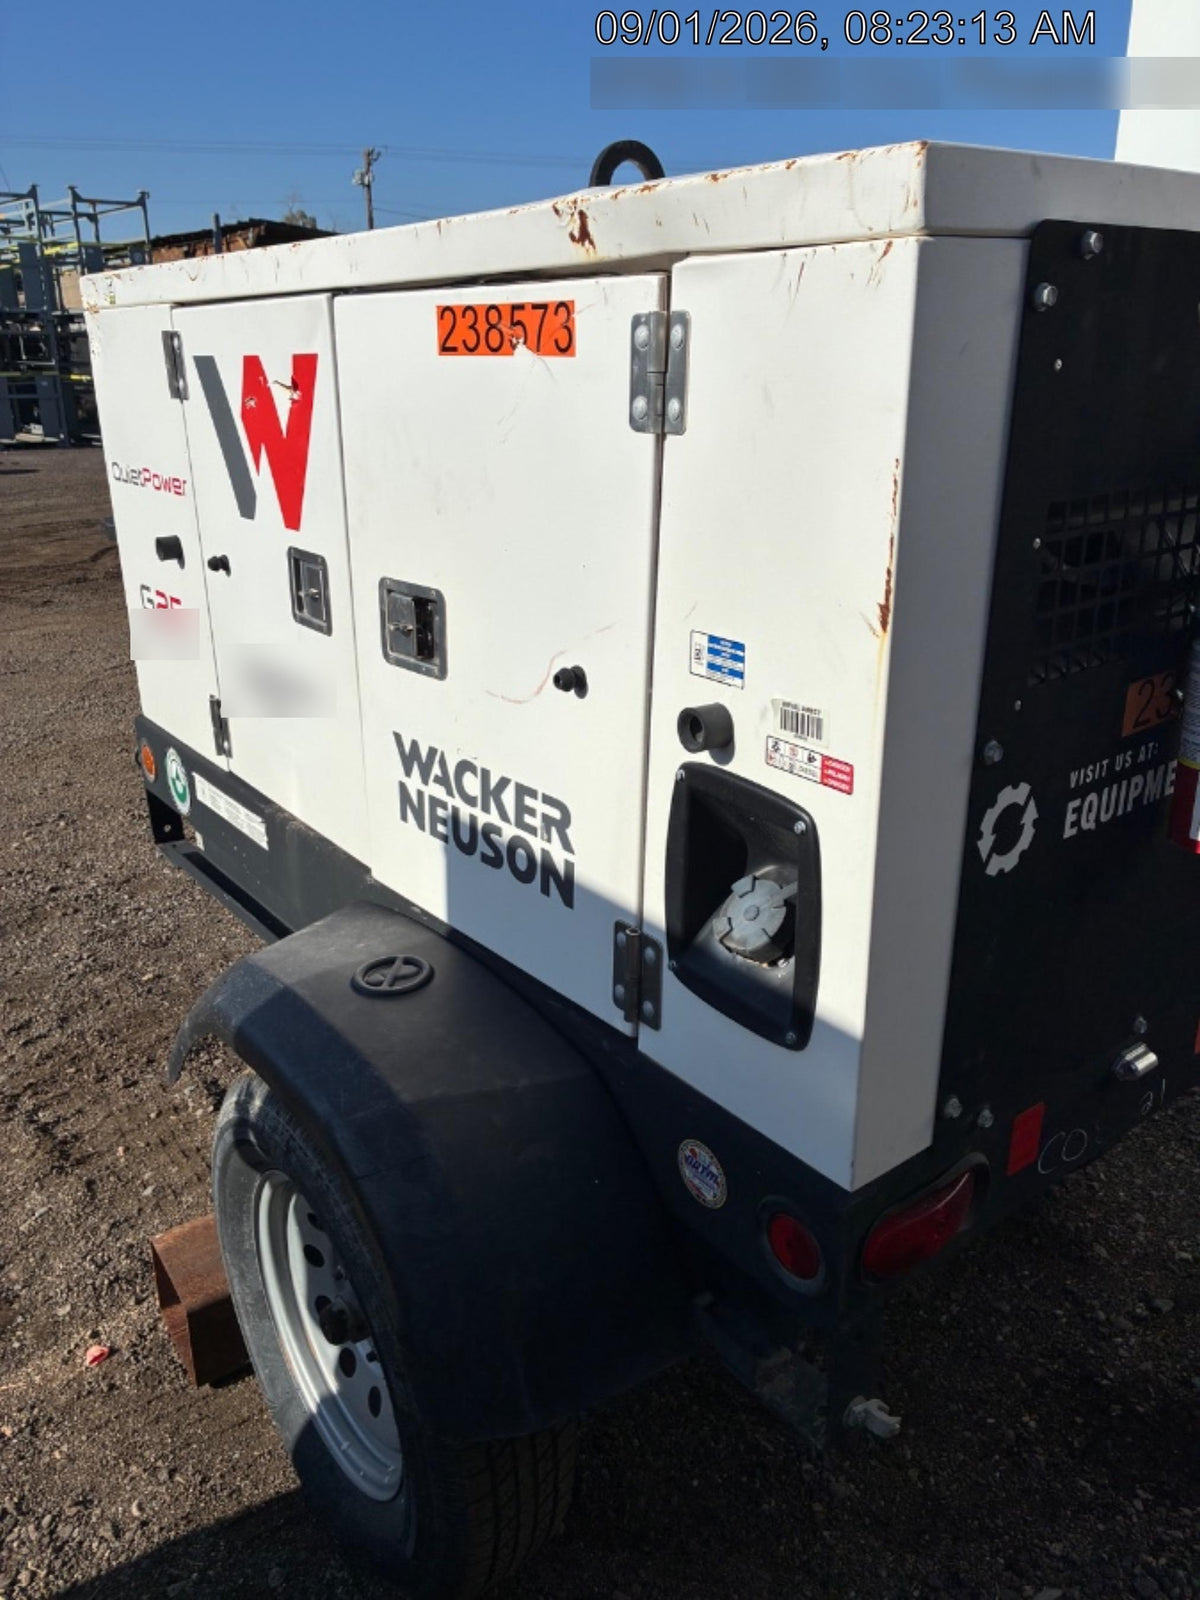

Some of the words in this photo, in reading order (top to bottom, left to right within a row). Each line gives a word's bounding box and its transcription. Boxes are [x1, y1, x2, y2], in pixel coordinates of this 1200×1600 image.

[440, 301, 574, 353] 238573
[111, 461, 187, 497] QuietPower
[1069, 758, 1109, 789] VISIT
[1115, 750, 1133, 772] US
[1137, 742, 1159, 765] AT:
[392, 730, 576, 856] WACKER
[398, 780, 575, 911] NEUSON
